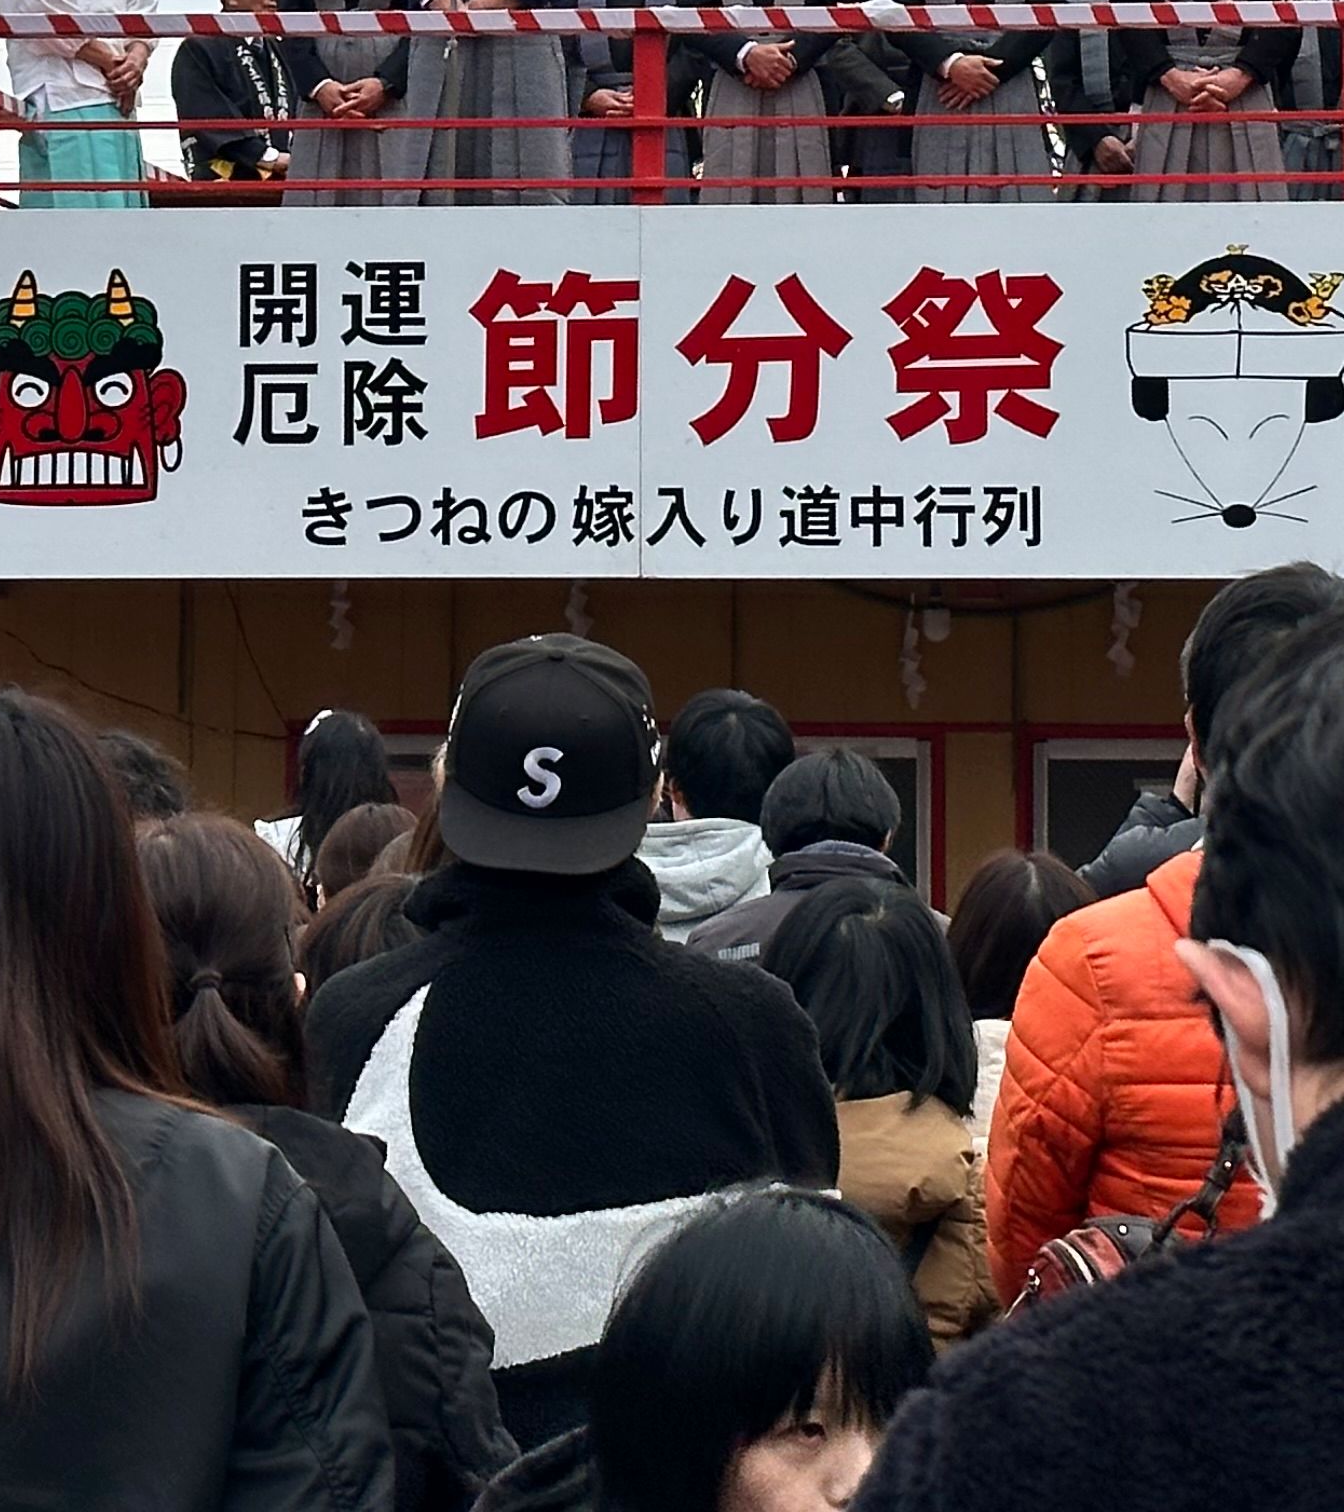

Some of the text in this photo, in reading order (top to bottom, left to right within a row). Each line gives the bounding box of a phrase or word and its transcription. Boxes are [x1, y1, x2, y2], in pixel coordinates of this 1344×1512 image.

[239, 260, 428, 348] 開運
[469, 267, 1064, 444] 節分祭
[232, 356, 429, 447] 厄除
[301, 485, 1043, 548] きつねの嫁入り道中行列
[517, 747, 564, 809] S
